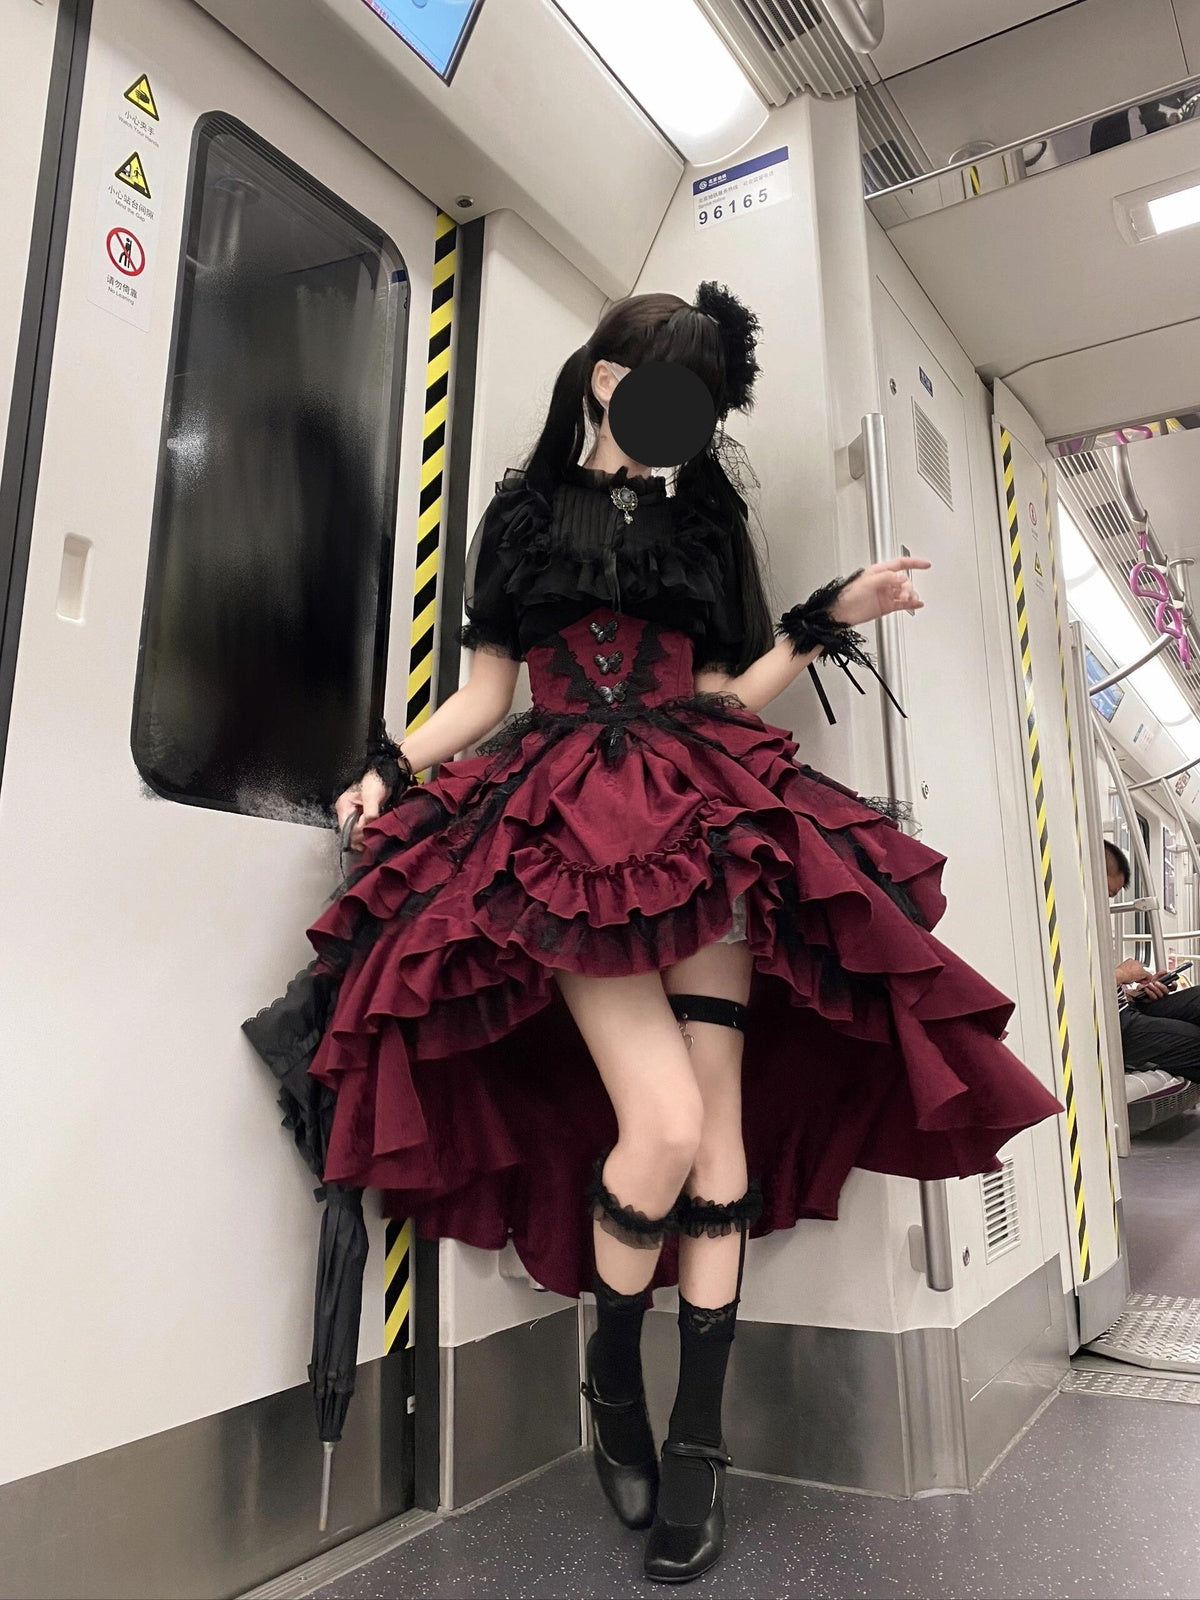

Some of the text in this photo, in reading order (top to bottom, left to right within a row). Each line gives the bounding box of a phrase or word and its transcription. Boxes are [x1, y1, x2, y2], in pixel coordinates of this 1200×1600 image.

[124, 110, 155, 136] 小心夹手
[107, 185, 155, 220] 小心站台间隙
[115, 199, 146, 222] Mind the Gap
[698, 188, 768, 225] 96165
[106, 274, 138, 299] 请勿倚靠
[108, 286, 135, 306] No Leaning
